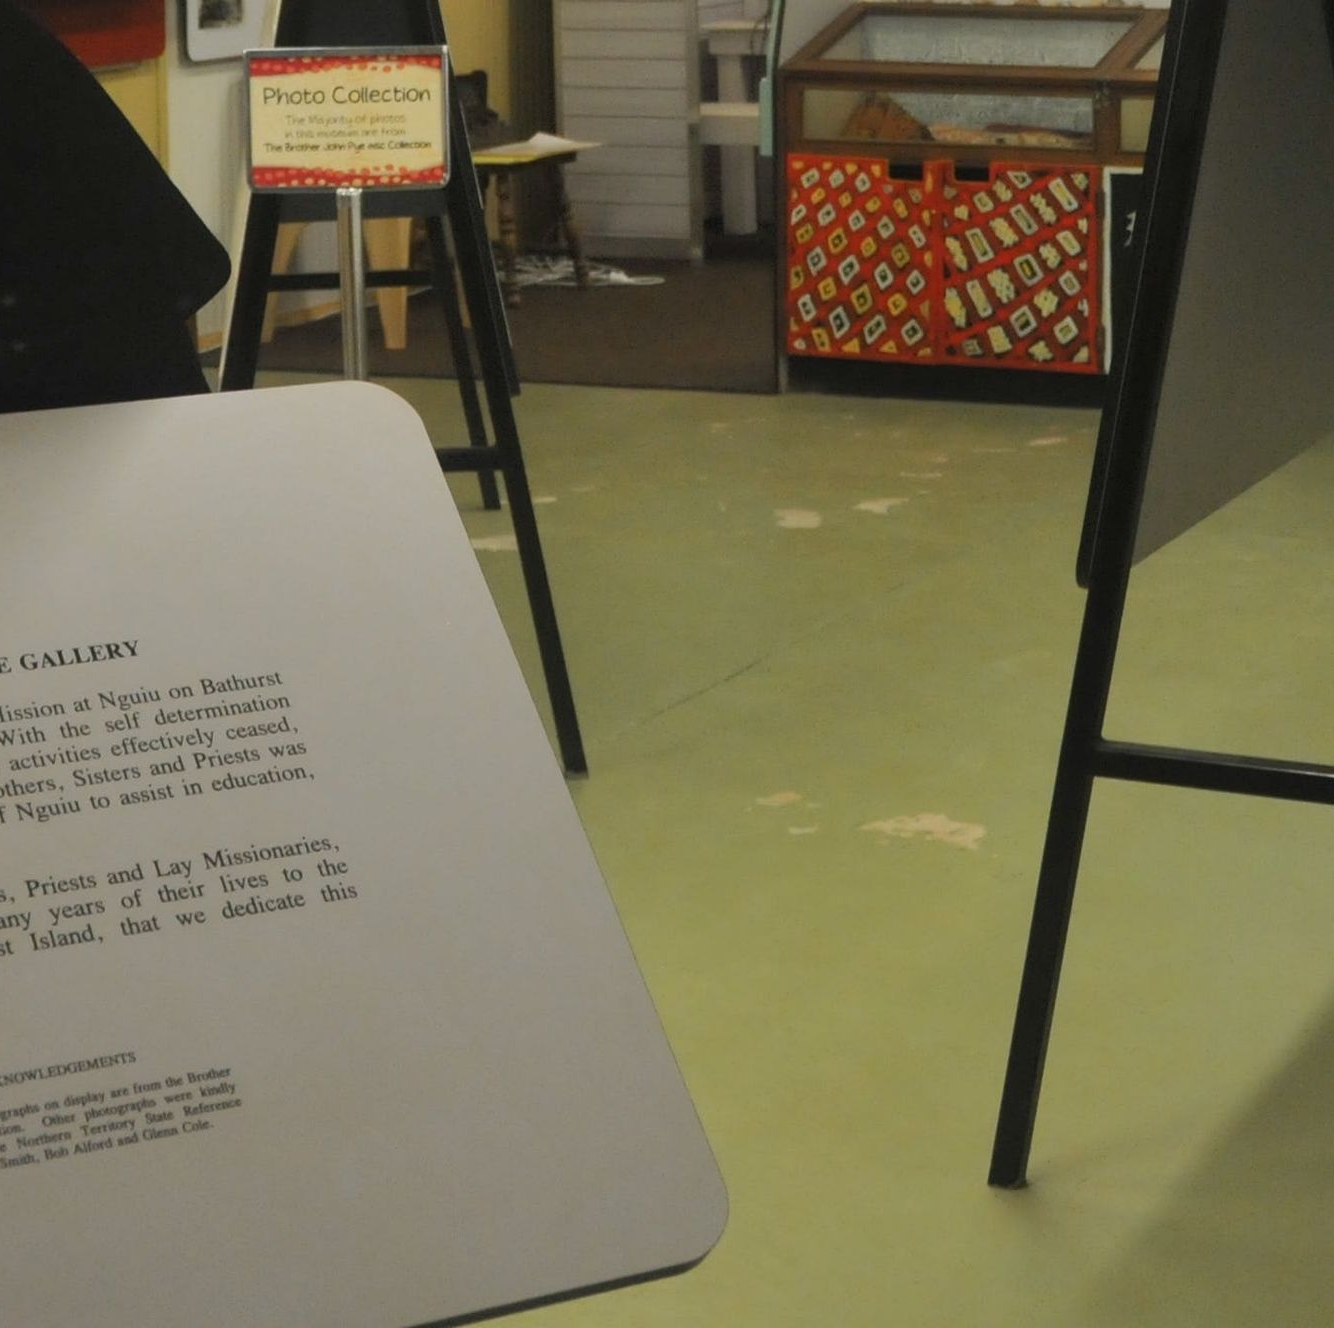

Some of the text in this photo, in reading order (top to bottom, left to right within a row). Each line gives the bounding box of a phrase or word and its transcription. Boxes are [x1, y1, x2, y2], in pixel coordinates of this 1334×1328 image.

[262, 85, 431, 105] Photo Collection
[264, 143, 283, 153] The
[284, 142, 321, 152] Brother
[324, 142, 346, 152] John
[347, 141, 366, 154] Pye
[387, 140, 432, 150] Collection
[18, 639, 139, 672] GALLERY
[72, 696, 93, 714] at
[96, 685, 162, 712] Nguiu
[167, 685, 196, 700] on
[198, 671, 284, 696] Bathurst
[58, 720, 92, 740] the
[104, 710, 141, 734] self
[153, 694, 292, 727] determination
[8, 744, 102, 772] activities
[109, 727, 215, 758] effectively
[225, 715, 299, 741] ceased,
[71, 765, 142, 788] Sisters
[148, 754, 187, 777] and
[191, 747, 261, 771] Priests
[267, 742, 308, 759] was
[14, 796, 82, 823] Nguiu
[88, 795, 111, 811] to
[119, 783, 176, 806] assist
[181, 778, 204, 797] in
[210, 764, 315, 792] education,
[23, 874, 98, 899] Priests
[106, 862, 146, 886] and
[151, 858, 192, 880] Lay
[201, 837, 340, 871] Missionaries,
[47, 900, 106, 927] years
[120, 888, 143, 910] of
[156, 883, 206, 904] their
[218, 873, 270, 894] lives
[281, 867, 304, 884] to
[316, 859, 349, 878] the
[28, 922, 104, 952] Island,
[119, 915, 162, 937] that
[174, 910, 207, 927] we
[221, 893, 307, 920] dedicate
[319, 884, 359, 903] this
[40, 1112, 77, 1129] Other
[82, 1096, 158, 1123] photographs
[162, 1090, 195, 1105] were
[197, 1081, 237, 1099] kindly
[42, 1099, 62, 1112] on
[62, 1090, 108, 1109] display
[108, 1086, 131, 1100] are
[131, 1080, 164, 1096] from
[163, 1075, 185, 1089] the
[185, 1067, 232, 1085] Brother
[15, 1130, 73, 1151] Northern
[78, 1116, 137, 1138] Territory
[143, 1110, 176, 1128] State
[181, 1097, 244, 1118] Reference
[42, 1145, 71, 1162] Bob
[116, 1130, 142, 1148] and
[140, 1125, 181, 1142] Glenn
